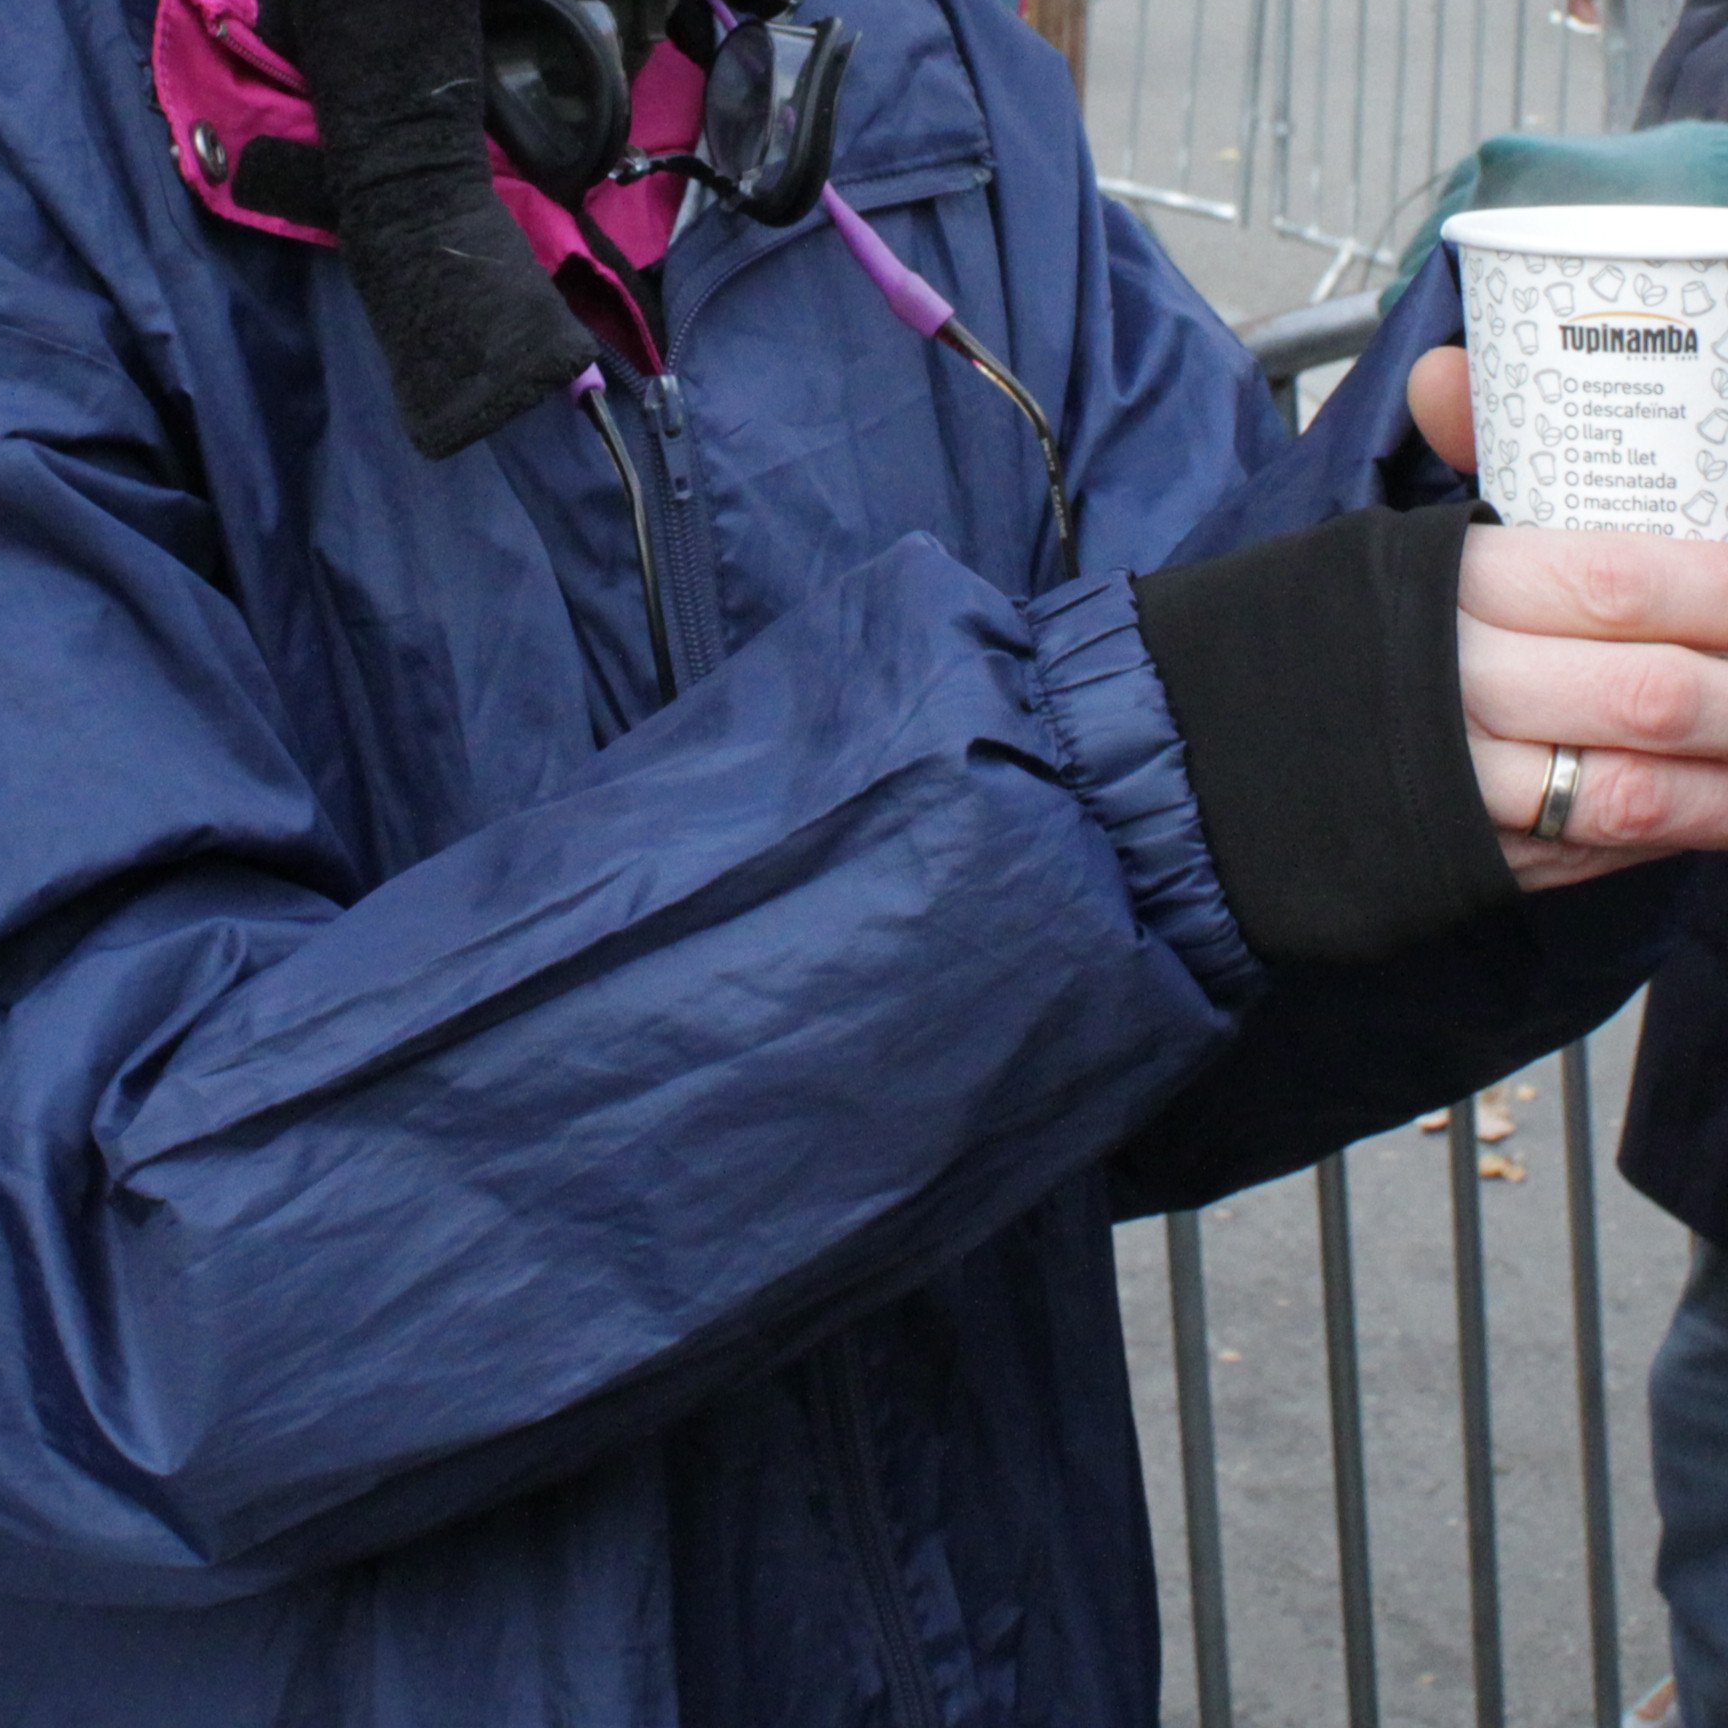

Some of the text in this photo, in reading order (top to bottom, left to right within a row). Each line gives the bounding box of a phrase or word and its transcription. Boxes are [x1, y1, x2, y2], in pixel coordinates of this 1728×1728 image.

[1582, 379, 1664, 397] espresso
[1582, 400, 1687, 419] descafeïnat
[1582, 423, 1623, 445] llarg
[1582, 448, 1657, 466] amb llet
[1583, 471, 1677, 489] desnatada
[1584, 494, 1677, 513] macchiato
